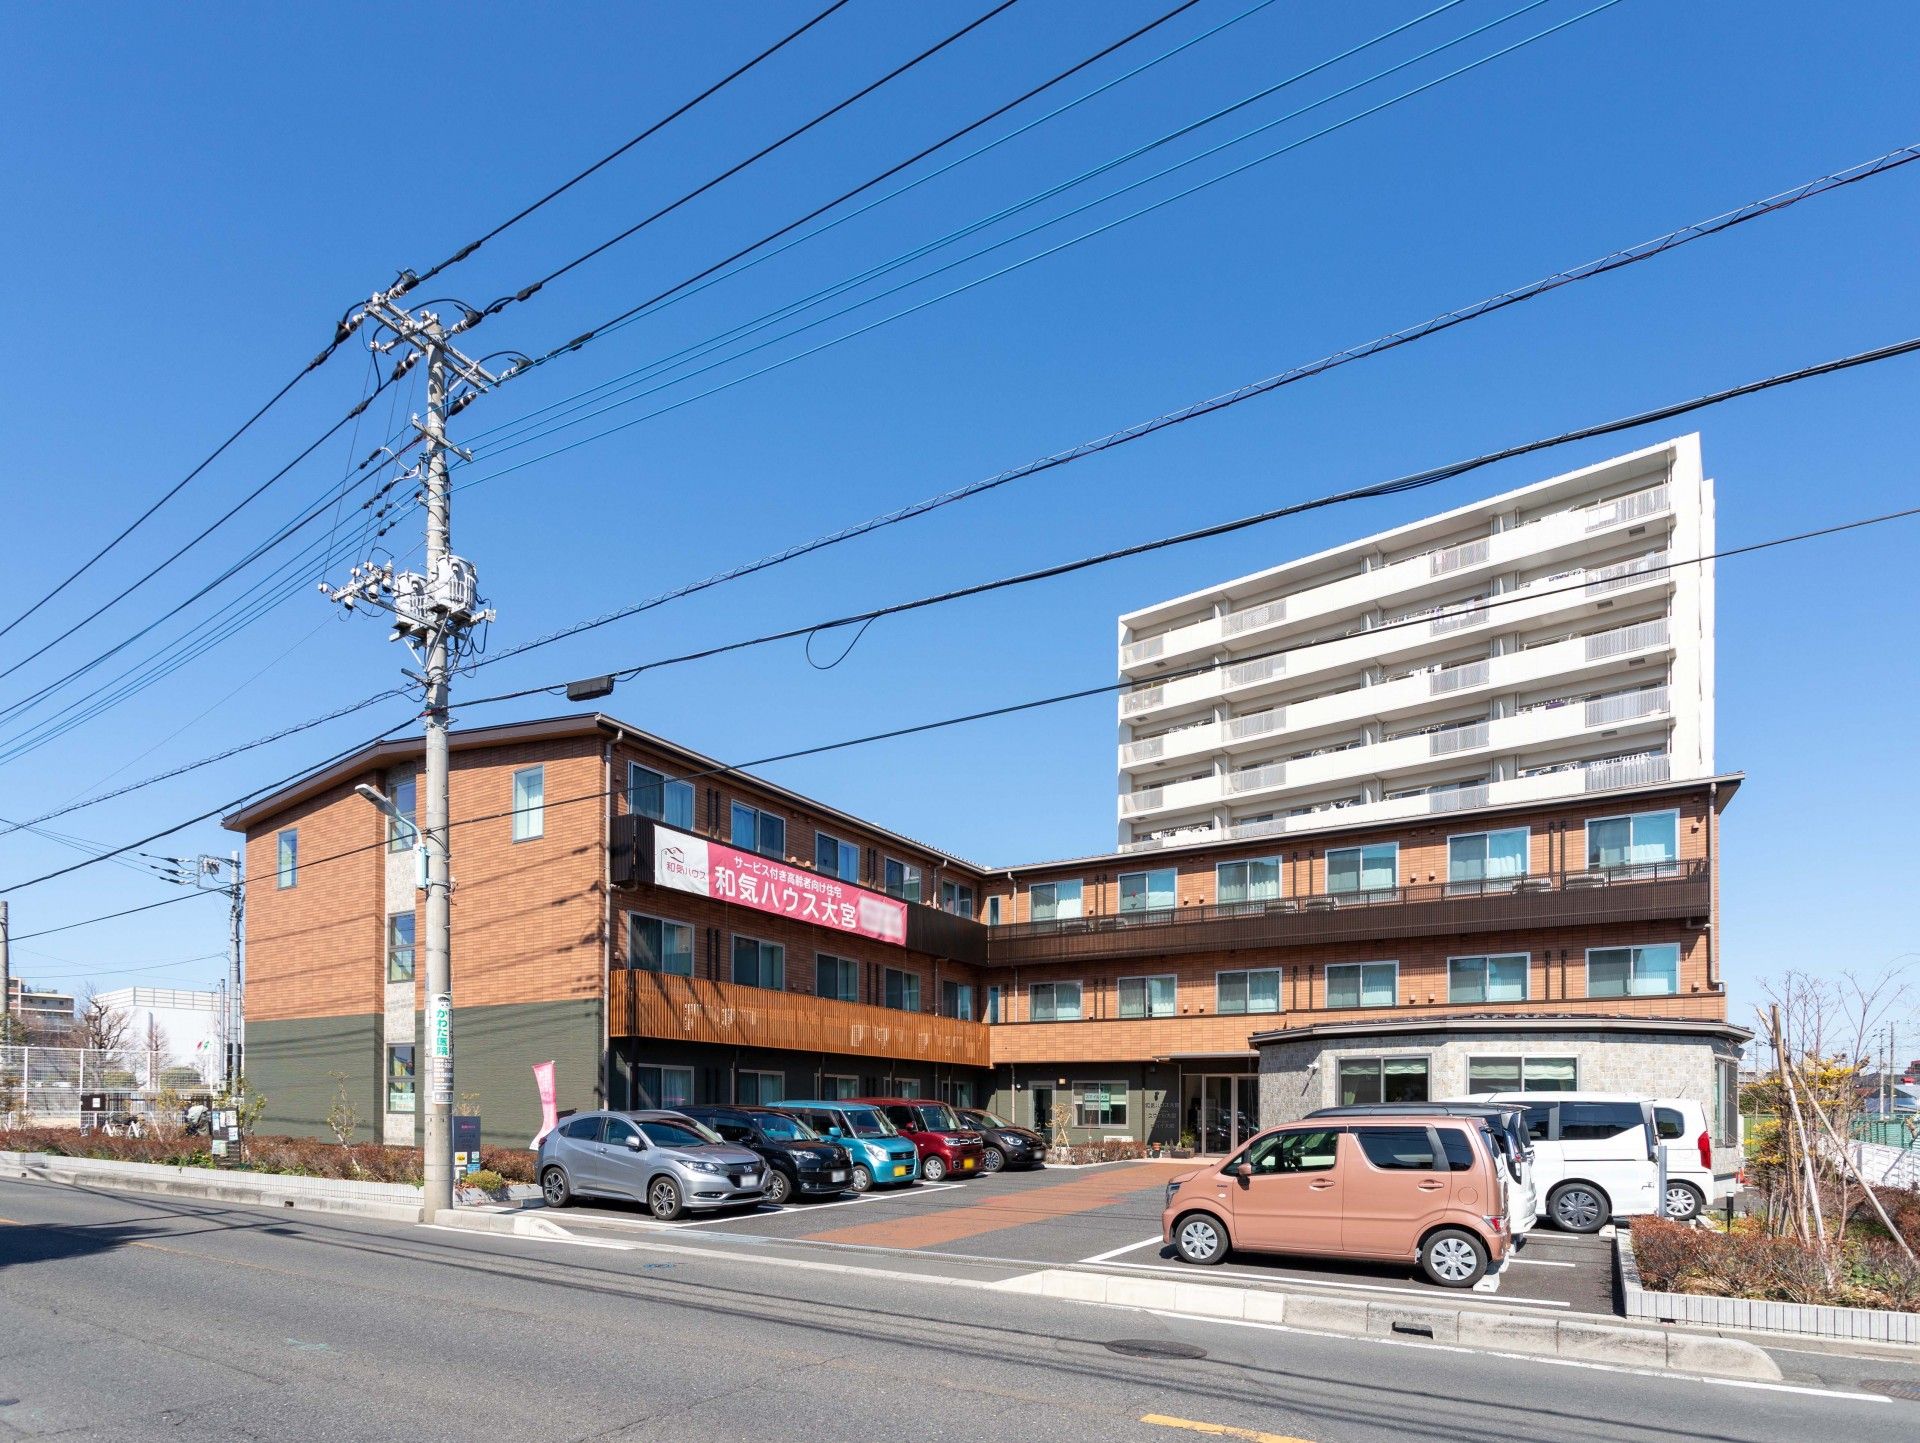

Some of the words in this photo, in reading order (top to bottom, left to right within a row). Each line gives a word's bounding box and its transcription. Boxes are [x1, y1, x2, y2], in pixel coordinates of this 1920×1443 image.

[666, 861, 706, 880] 和気ハウス
[734, 856, 842, 898] サービス付き高齢者向け住宅
[715, 865, 857, 928] 和気ハウス大宮
[436, 1008, 449, 1056] かわた医院
